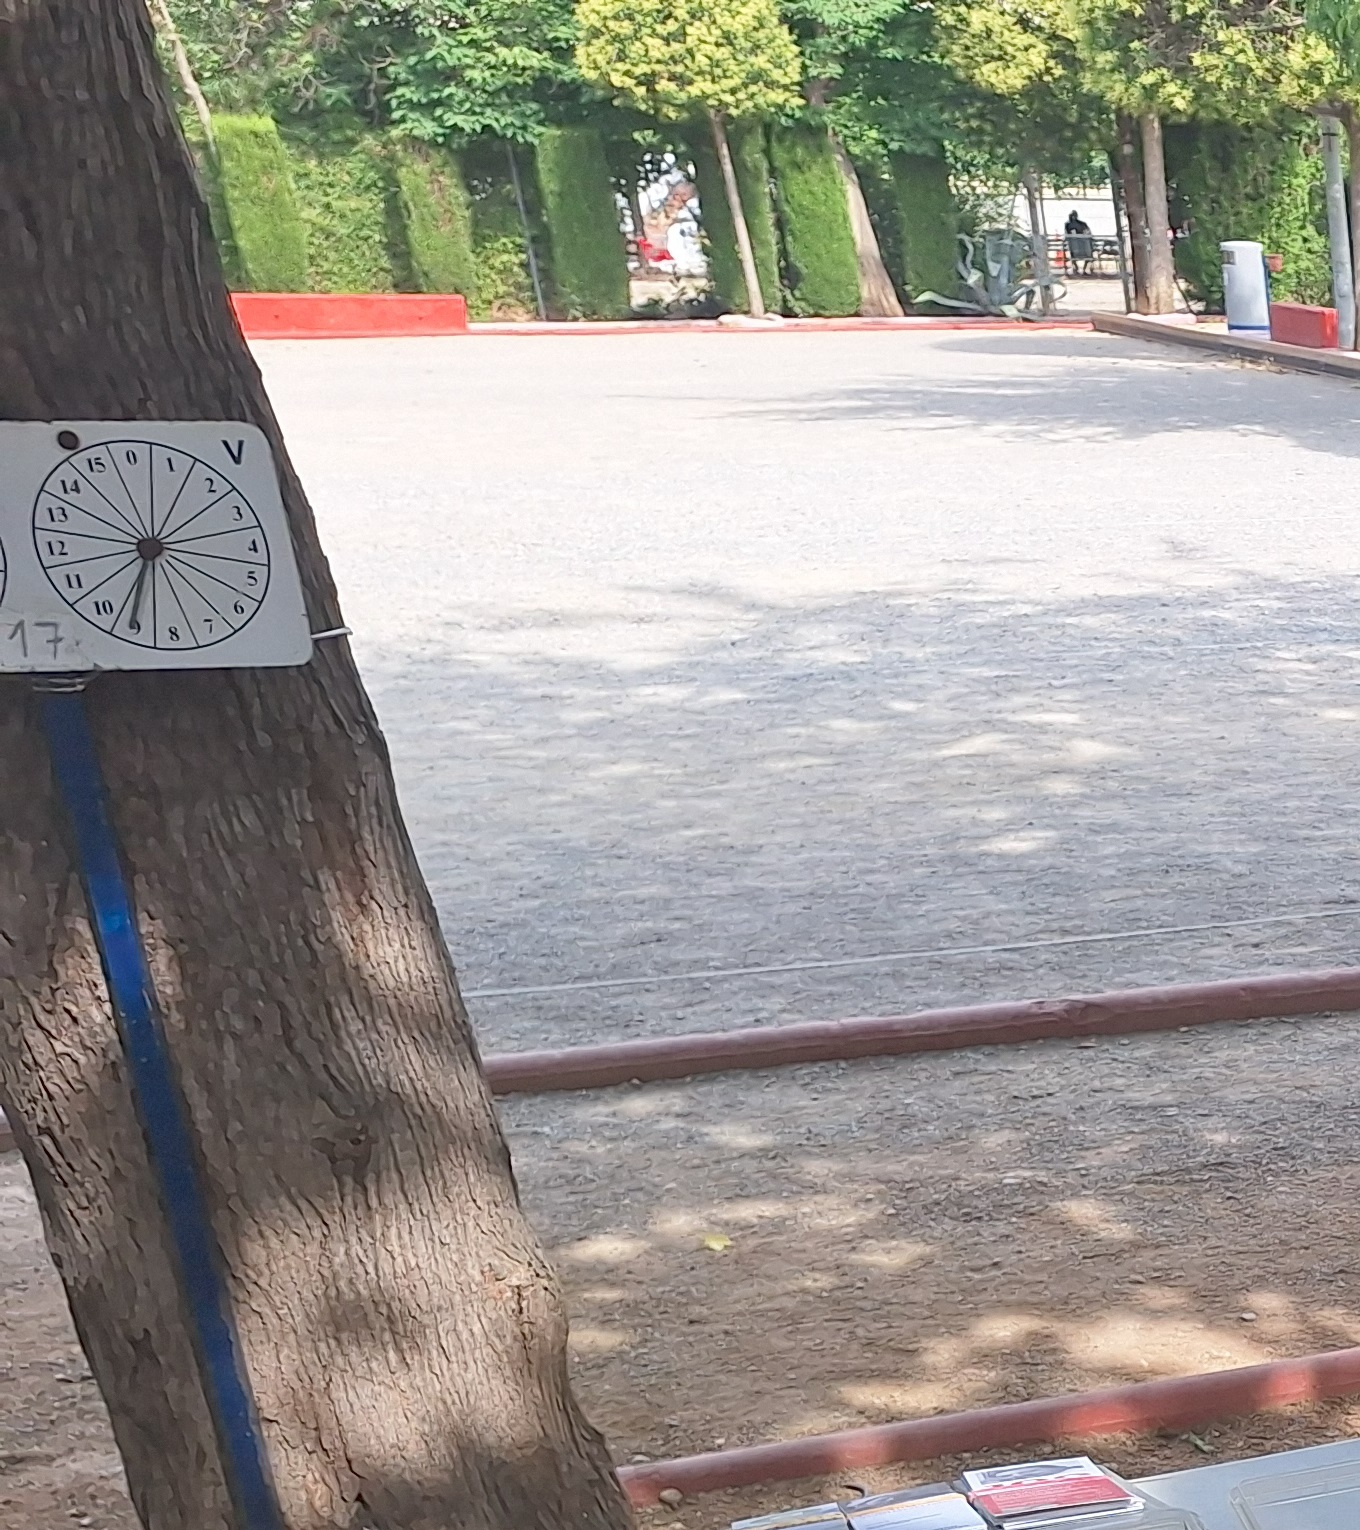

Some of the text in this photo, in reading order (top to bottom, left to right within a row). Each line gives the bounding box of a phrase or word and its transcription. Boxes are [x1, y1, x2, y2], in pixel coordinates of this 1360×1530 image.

[126, 450, 138, 466] 0
[221, 440, 244, 465] V
[87, 457, 107, 474] 15
[167, 457, 174, 473] 1
[60, 478, 81, 495] 14
[204, 477, 217, 494] 2
[46, 507, 68, 523] 13
[232, 506, 244, 521] 3
[46, 540, 69, 557] 12
[247, 537, 259, 554] 4
[64, 573, 84, 590] 11
[246, 571, 259, 587] 5
[93, 599, 114, 616] 10
[233, 600, 245, 616] 6
[168, 626, 180, 642] 8
[202, 618, 214, 634] 7
